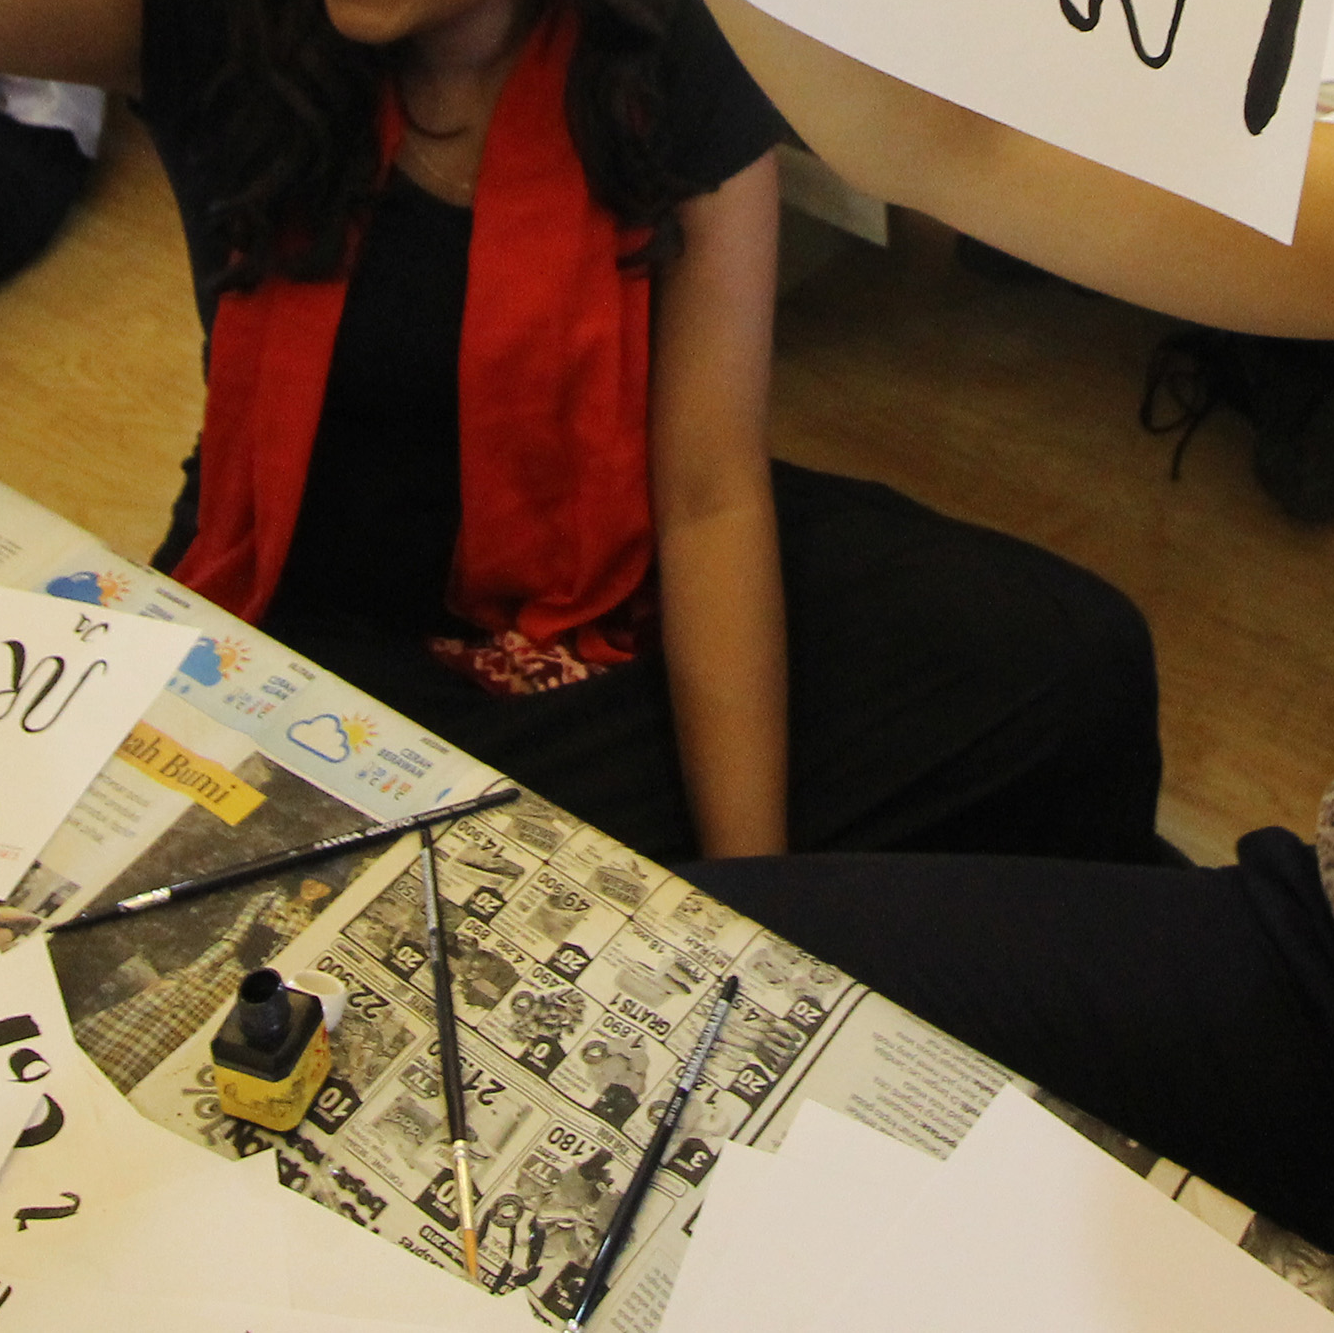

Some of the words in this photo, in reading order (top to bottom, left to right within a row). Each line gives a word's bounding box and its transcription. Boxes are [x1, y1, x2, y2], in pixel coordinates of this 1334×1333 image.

[157, 747, 237, 811] Bumi
[452, 817, 508, 862] 14.900
[473, 888, 504, 916] 20
[532, 869, 593, 918] 49.900
[462, 916, 492, 942] 890
[394, 941, 424, 970] 20
[556, 944, 587, 973] 20
[607, 989, 624, 1009] 1
[790, 996, 824, 1026] 20
[597, 1010, 648, 1054] 1.890
[616, 993, 674, 1040] GRATIS
[404, 1066, 434, 1093] TV
[669, 1063, 723, 1107] 1.20
[735, 1065, 769, 1096] 20
[314, 1080, 357, 1121] 10
[543, 1120, 597, 1166] .180
[526, 1155, 555, 1182] TV
